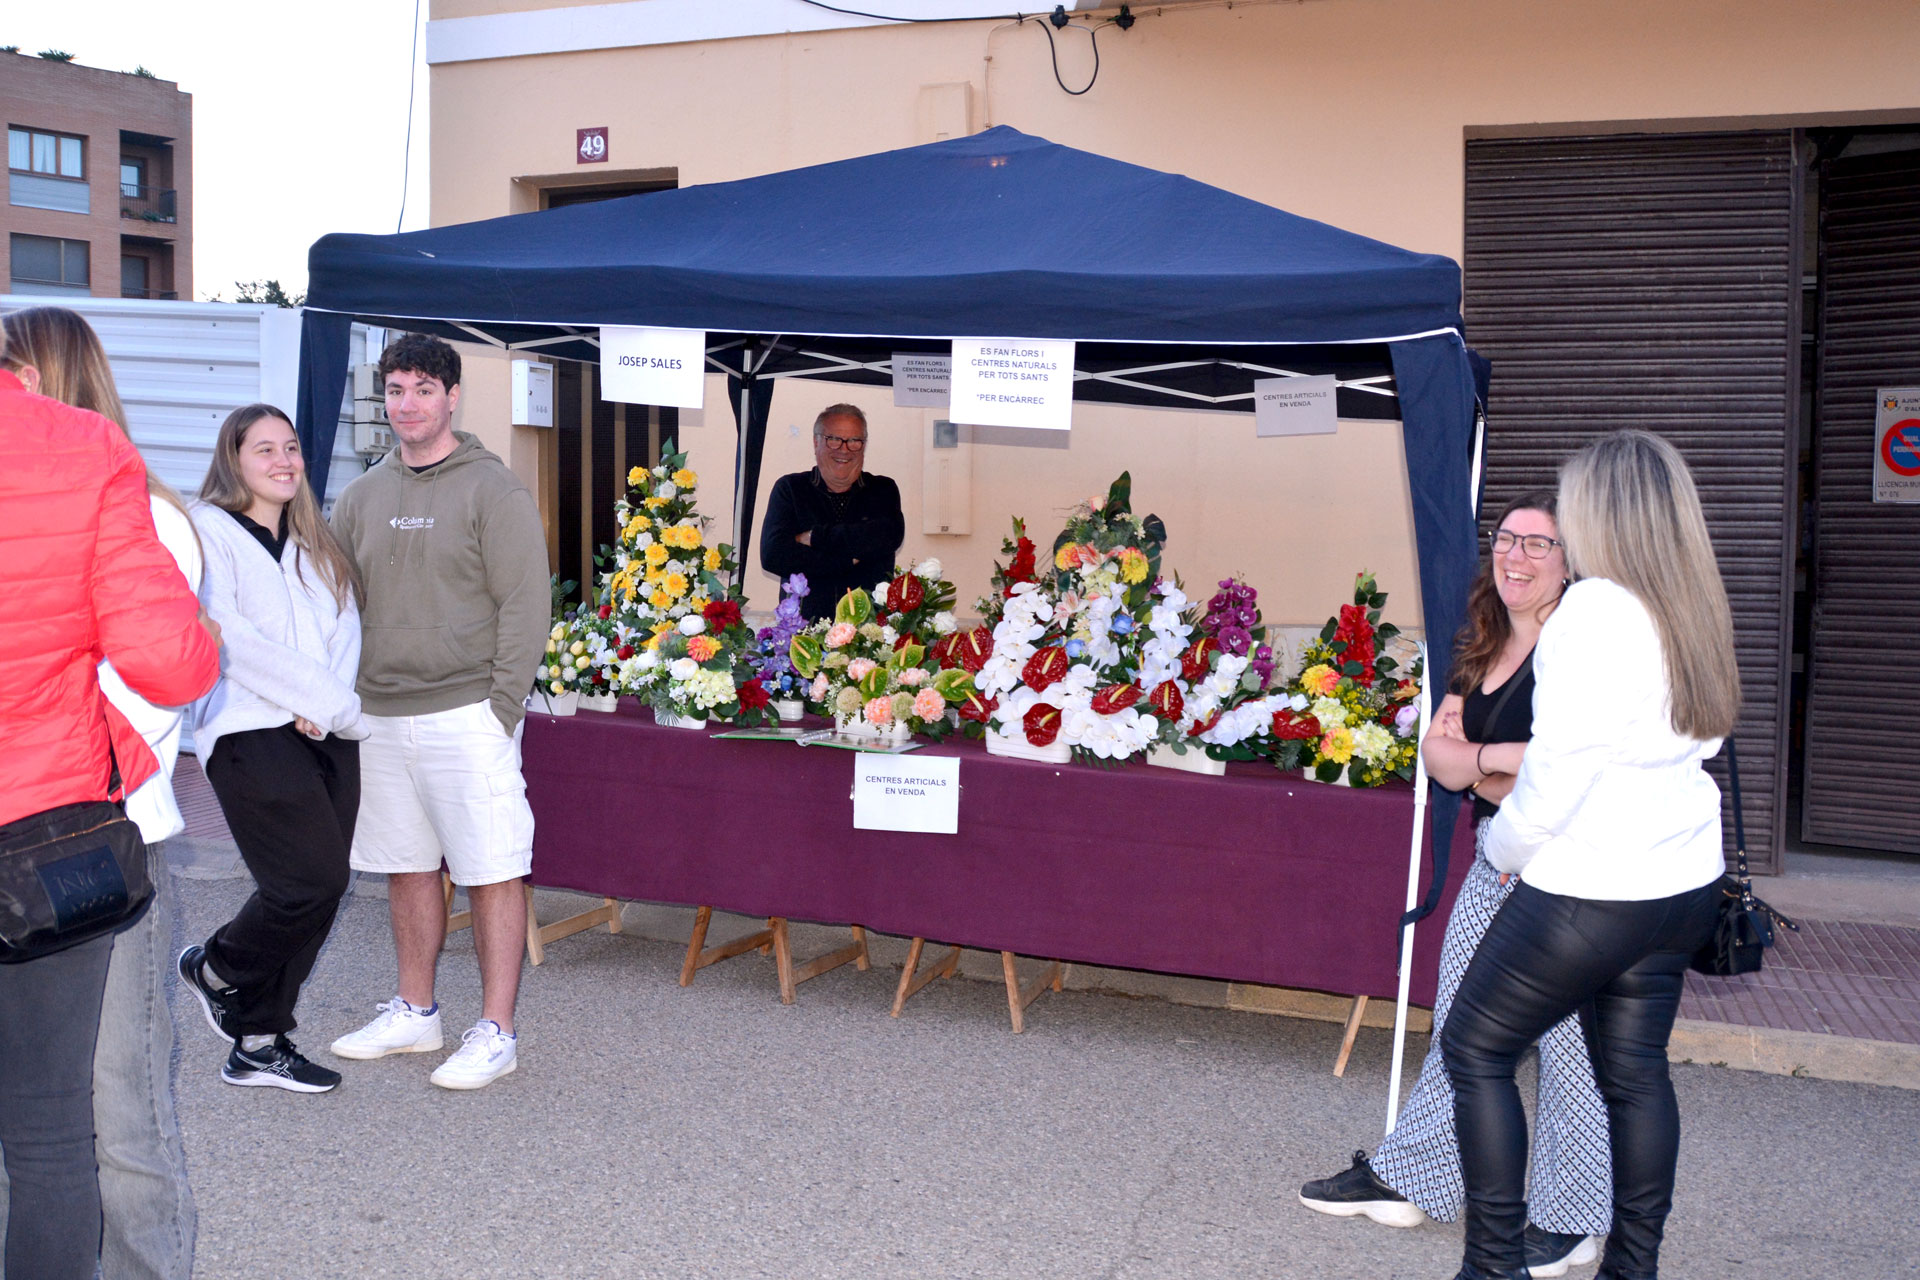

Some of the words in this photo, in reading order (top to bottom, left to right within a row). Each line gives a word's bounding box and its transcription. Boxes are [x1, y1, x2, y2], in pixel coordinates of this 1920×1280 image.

[580, 135, 605, 155] 49
[980, 347, 992, 355] ES
[993, 348, 1009, 356] FAN
[1011, 349, 1039, 358] FLORS
[618, 355, 648, 367] JOSEP
[650, 357, 682, 370] SALES
[971, 358, 1010, 368] CENTRES
[1012, 360, 1057, 370] NATURALS
[978, 370, 996, 379] PER
[998, 371, 1019, 380] TOTS
[1020, 372, 1049, 382] SANTS
[1263, 393, 1293, 401] CENTRES
[1294, 391, 1327, 399] ARTICIALS
[865, 775, 902, 784] CENTRES
[904, 777, 947, 787] ARTICIALS
[885, 787, 896, 795] EN
[898, 788, 926, 796] VENDA
